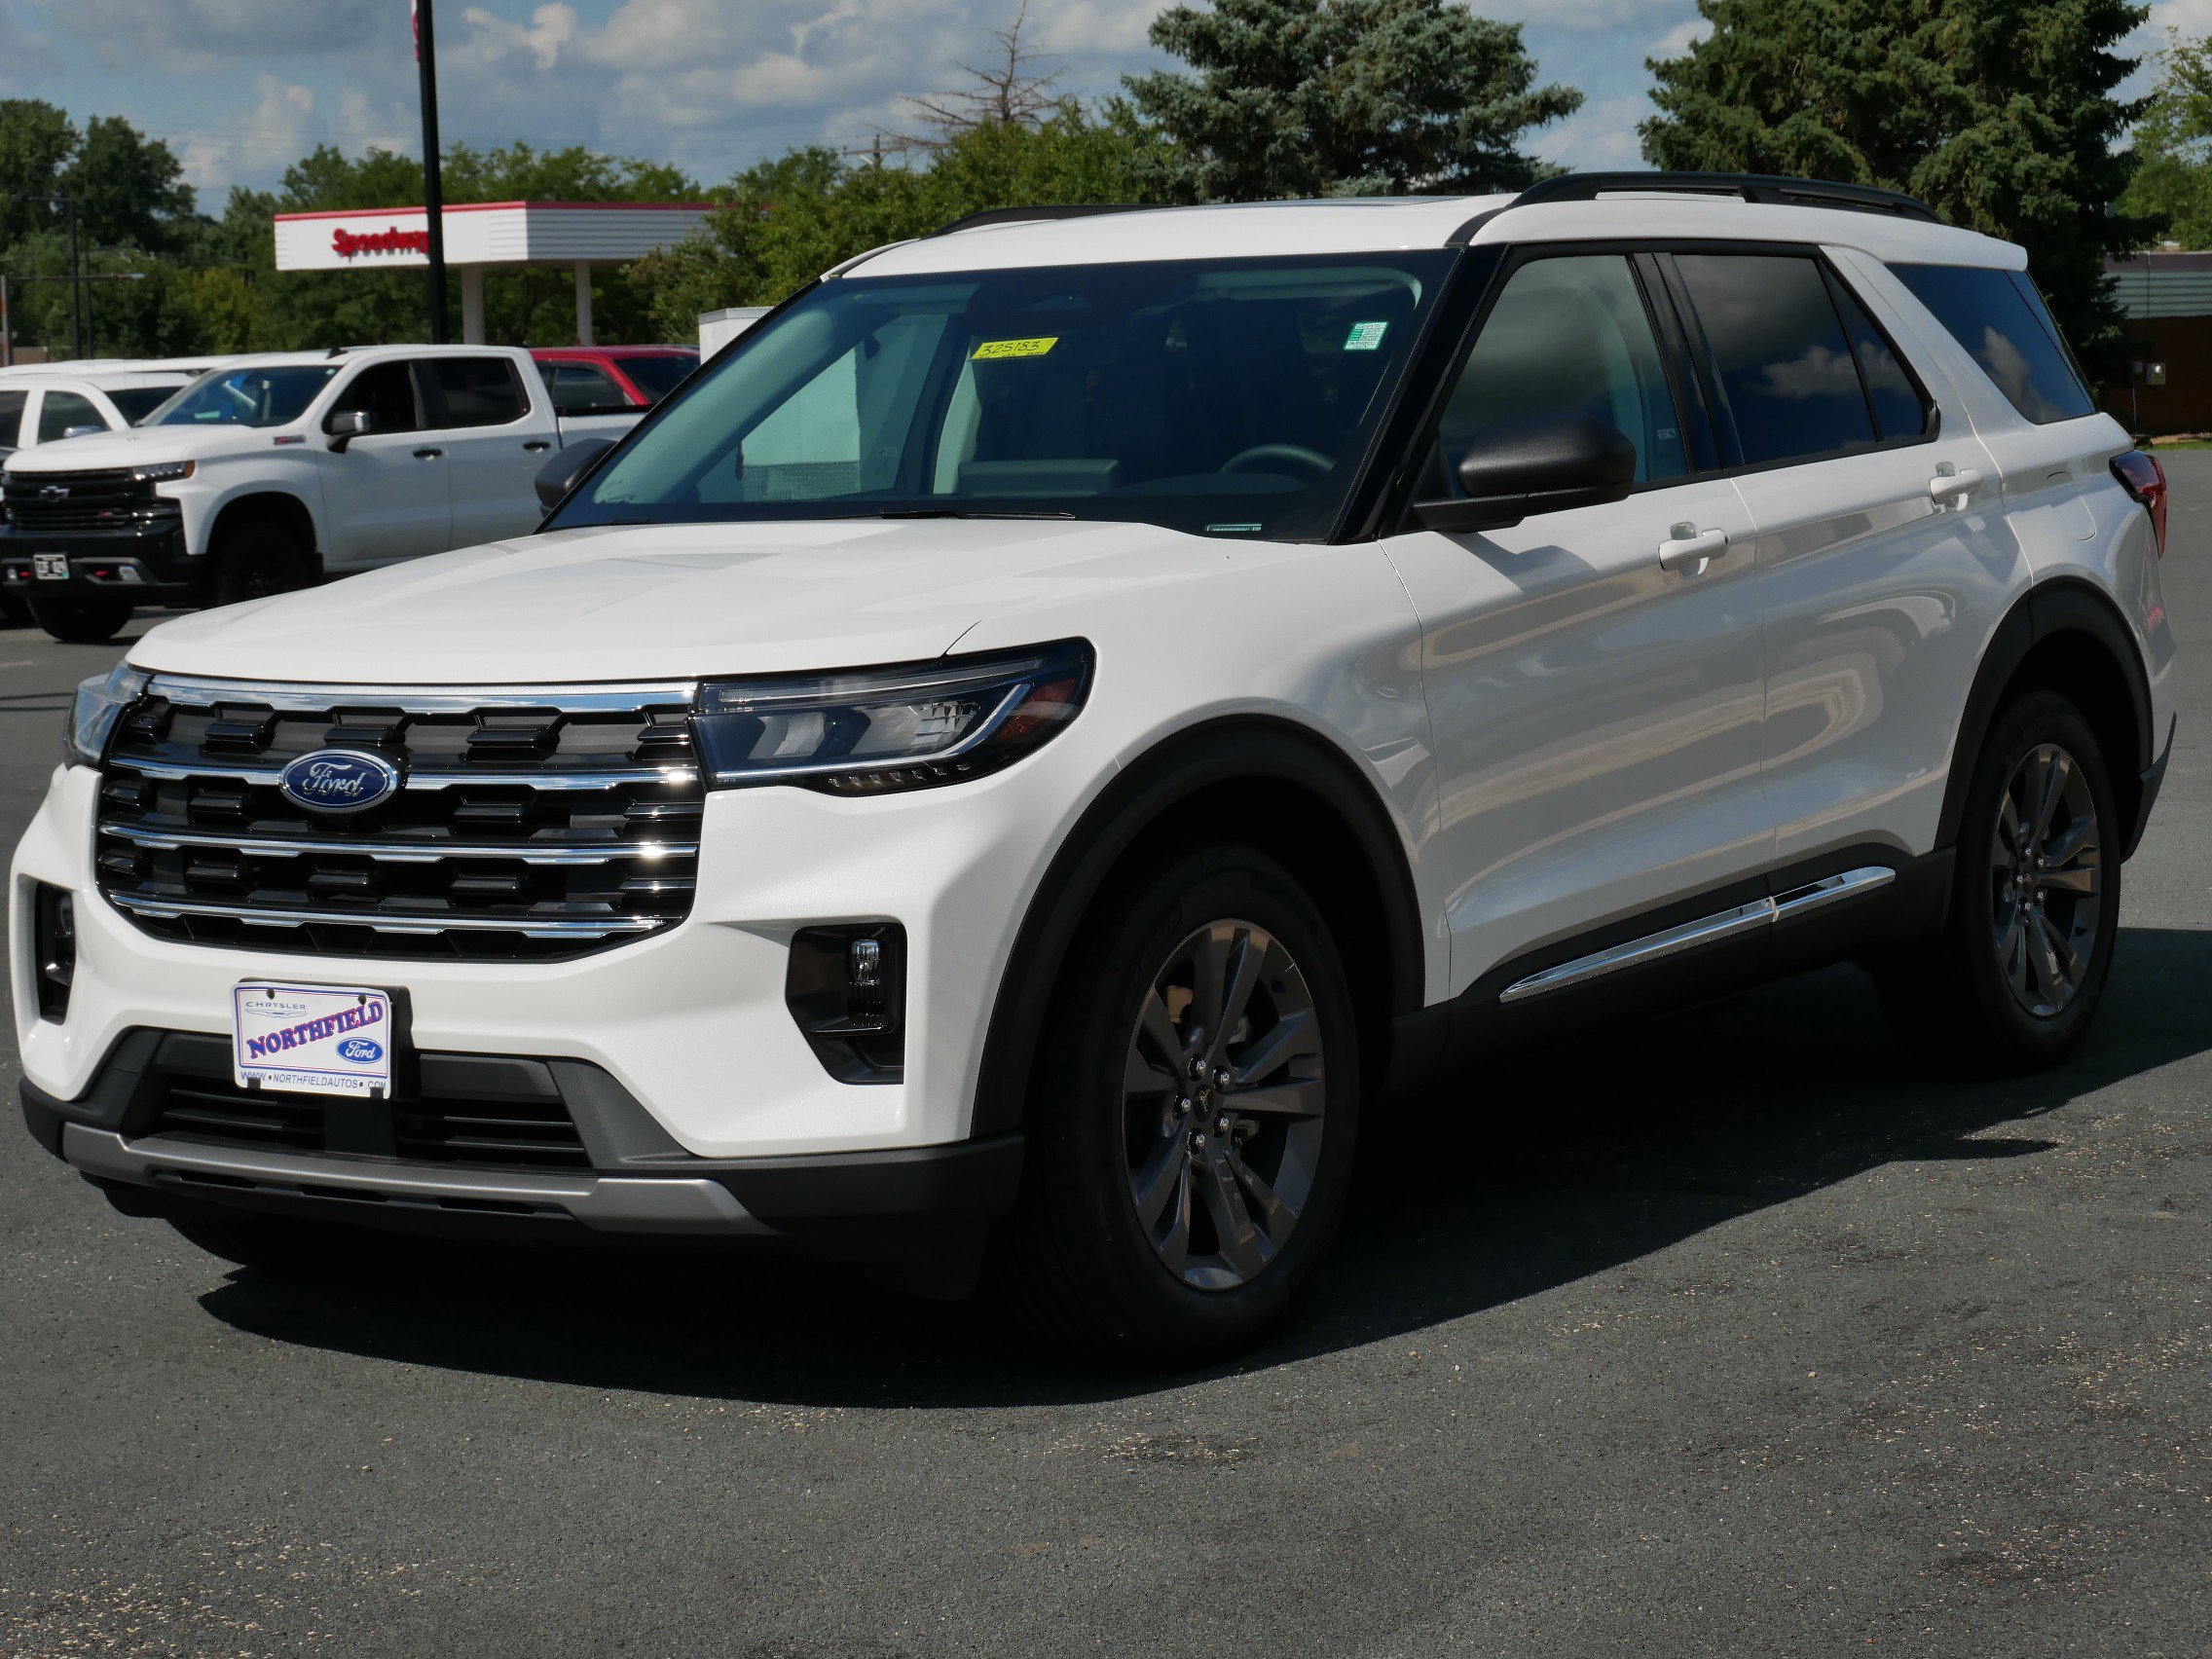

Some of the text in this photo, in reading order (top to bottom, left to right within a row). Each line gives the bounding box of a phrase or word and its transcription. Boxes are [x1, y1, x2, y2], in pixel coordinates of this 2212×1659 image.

[302, 761, 365, 796] Ford
[245, 1001, 307, 1010] CHRYSLER
[246, 1000, 384, 1059] NORTHFIELD
[345, 1041, 376, 1059] Ford
